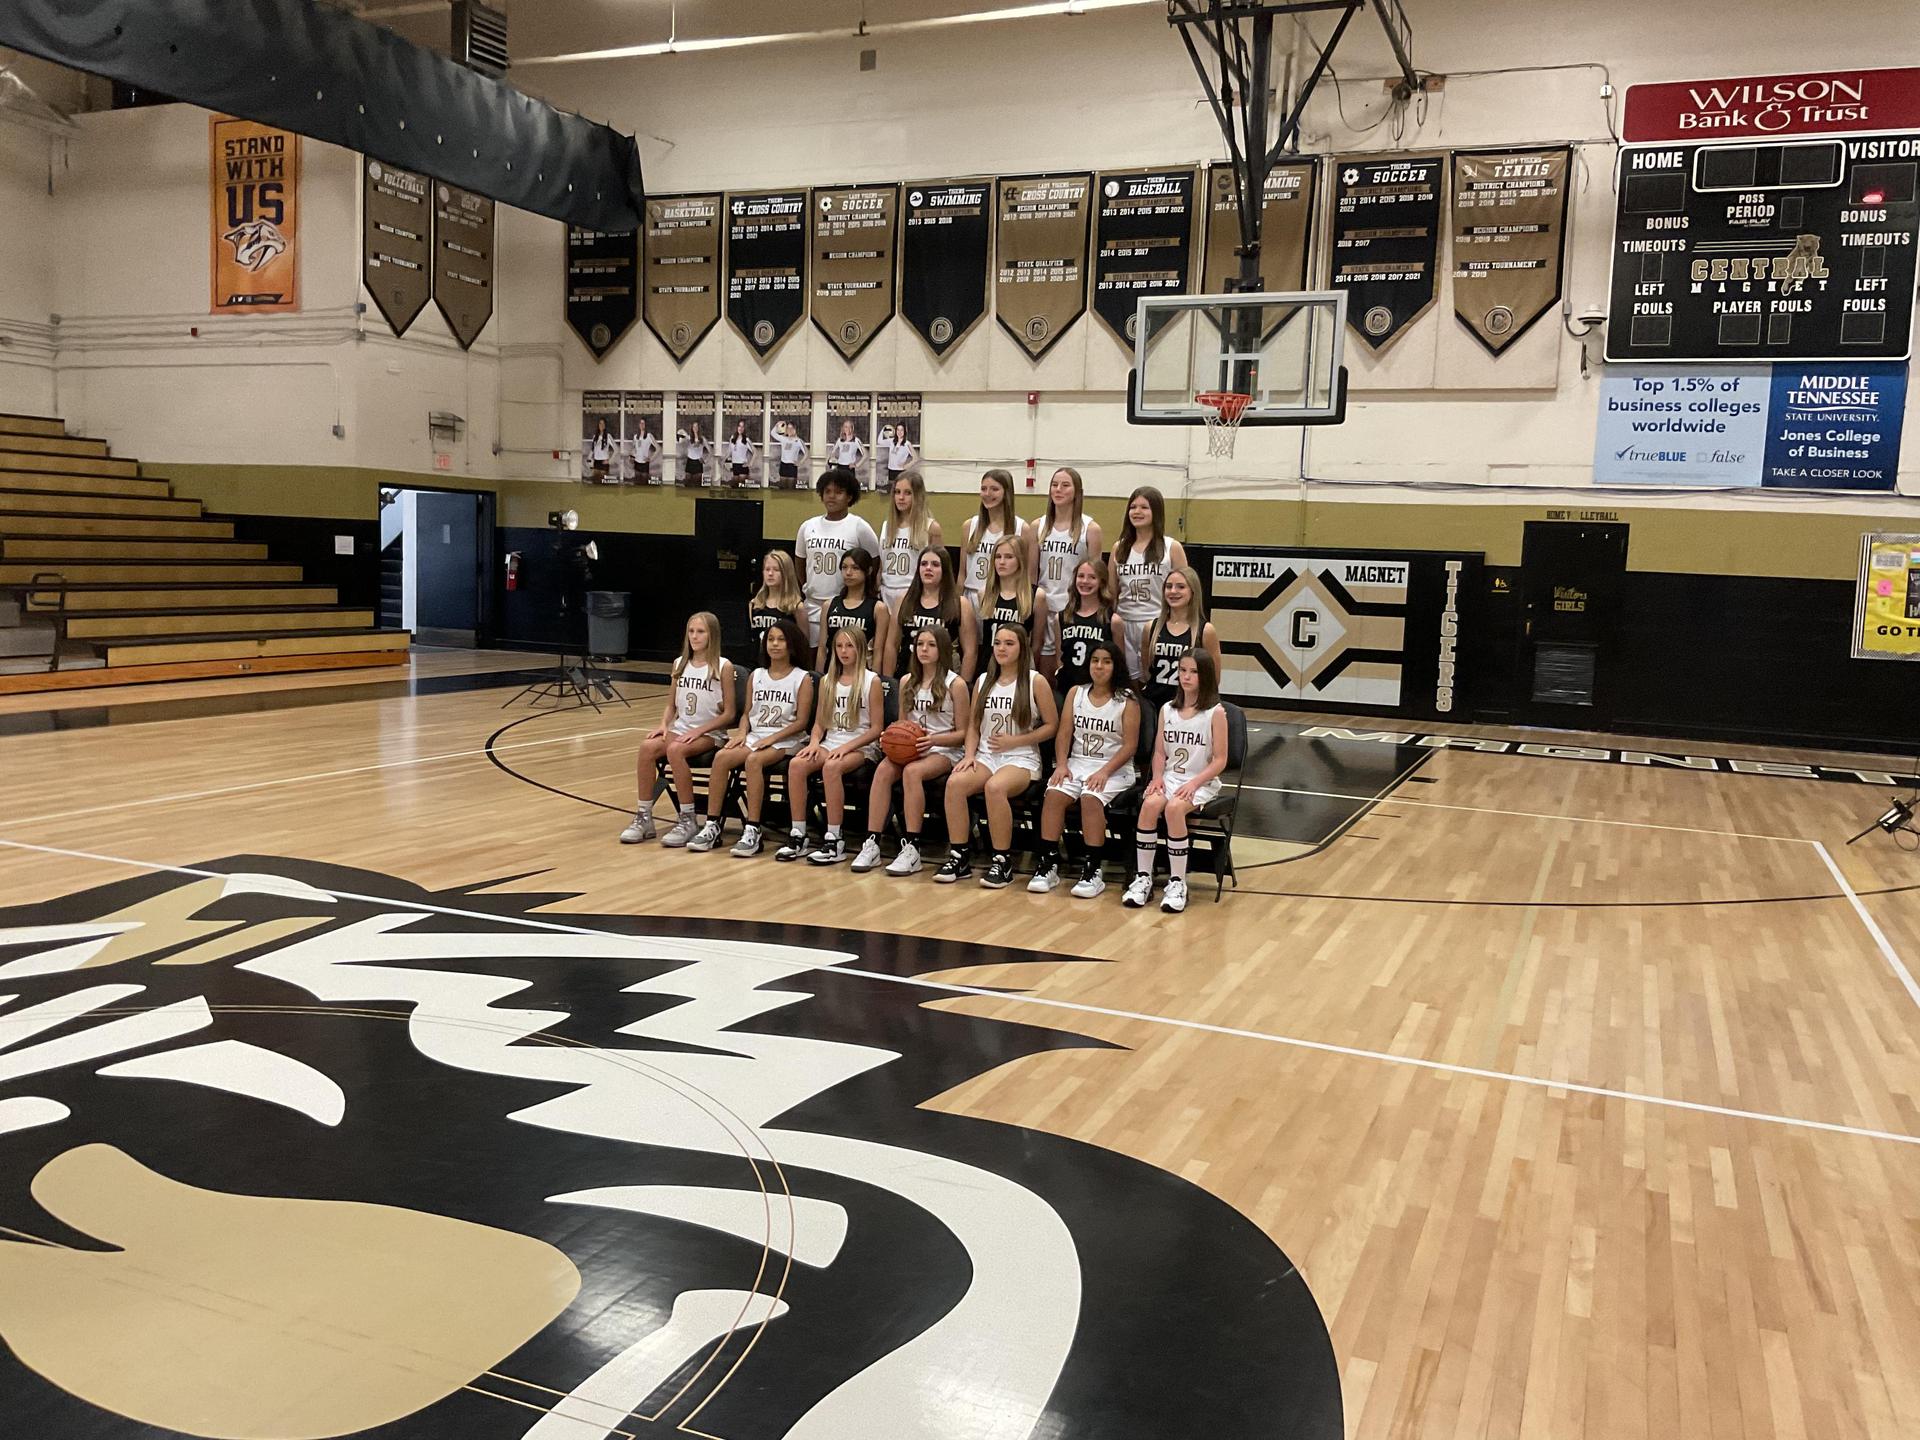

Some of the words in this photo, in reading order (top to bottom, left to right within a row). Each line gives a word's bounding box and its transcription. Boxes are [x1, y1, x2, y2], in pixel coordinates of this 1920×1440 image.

[1689, 79, 1863, 110] WILSON
[1679, 110, 1748, 129] Bank
[1754, 103, 1791, 131] &
[1798, 105, 1869, 122] Trust
[225, 136, 284, 156] STAND
[1632, 152, 1683, 169] HOME
[226, 158, 283, 180] WITH
[1494, 163, 1550, 178] TENNIS
[384, 173, 424, 195] VOLLEYBALL
[1372, 170, 1427, 184] SOCCER
[1128, 183, 1181, 196] BASEBALL
[1473, 182, 1504, 190] DISTRICT
[1506, 180, 1546, 189] CHAMPIONS
[930, 194, 982, 206] SWIMMING
[1021, 190, 1047, 201] CROSS
[1049, 187, 1085, 199] COUNTRY
[1359, 196, 1376, 204] 2014
[1738, 194, 1765, 204] POSS
[226, 183, 284, 228] US
[664, 206, 715, 219] BASKETBALL
[747, 205, 770, 215] CROSS
[771, 202, 803, 214] COUNTRY
[842, 199, 884, 211] SOCCER
[1119, 208, 1134, 216] 2014
[1726, 204, 1775, 218] PERIOD
[1646, 217, 1689, 230] BONUS
[1840, 209, 1887, 223] BONUS
[1622, 239, 1686, 253] TIMEOUTS
[1841, 232, 1910, 246] TIMEOUTS
[1100, 249, 1115, 257] 2014
[1469, 262, 1490, 270] STATE
[1492, 260, 1537, 269] TOURNAMENT
[1691, 256, 1829, 281] CENTRAL
[1115, 281, 1130, 289] 2014
[1335, 274, 1351, 283] 2014
[1634, 284, 1664, 295] LEFT
[1855, 279, 1887, 291] LEFT
[1633, 303, 1673, 314] FOULS
[1713, 301, 1761, 313] PLAYER
[1770, 300, 1812, 312] FOULS
[1843, 298, 1886, 311] FOULS
[1633, 378, 1664, 395] Top
[1672, 378, 1714, 392] 1.5%
[1720, 378, 1740, 392] of
[1800, 375, 1869, 390] MIDDLE
[1787, 391, 1880, 405] TENNESSEE
[1608, 397, 1682, 412] business
[1688, 398, 1761, 417] colleges
[1785, 413, 1813, 421] STATE
[1632, 418, 1726, 433] worldwide
[1780, 430, 1821, 441] Jones
[1825, 430, 1881, 445] College
[1710, 450, 1745, 464] false
[1788, 445, 1805, 457] of
[1808, 446, 1869, 458] Business
[1772, 468, 1796, 477] TAKE
[1799, 468, 1808, 477] A
[1810, 469, 1850, 478] CLOSER
[1853, 469, 1883, 479] LOOK
[1546, 510, 1565, 520] HOME
[1566, 510, 1619, 521] VLLEYBALL
[807, 538, 847, 551] CENTRAL
[813, 551, 837, 575] 30
[886, 552, 910, 576] 20
[1048, 556, 1063, 580] 11
[1118, 563, 1163, 576] CENTRAL
[1215, 561, 1275, 579] CENTRAL
[1345, 565, 1405, 584] MAGNET
[1129, 578, 1152, 602] 15
[1554, 600, 1585, 612] GIRLS
[1063, 625, 1104, 642] CENTRAL
[1290, 608, 1320, 650] C
[1436, 560, 1463, 712] TIGERS
[1877, 625, 1902, 637] GO
[1072, 641, 1087, 666] 3
[678, 676, 713, 692] ENTRAL
[685, 692, 697, 716] 3
[754, 690, 793, 704] CENTRAL
[757, 705, 782, 727] 22
[1082, 733, 1105, 758] 12
[1164, 730, 1207, 746] CENTRAL
[1174, 747, 1190, 774] 2
[1299, 726, 1920, 785] MAGNET
